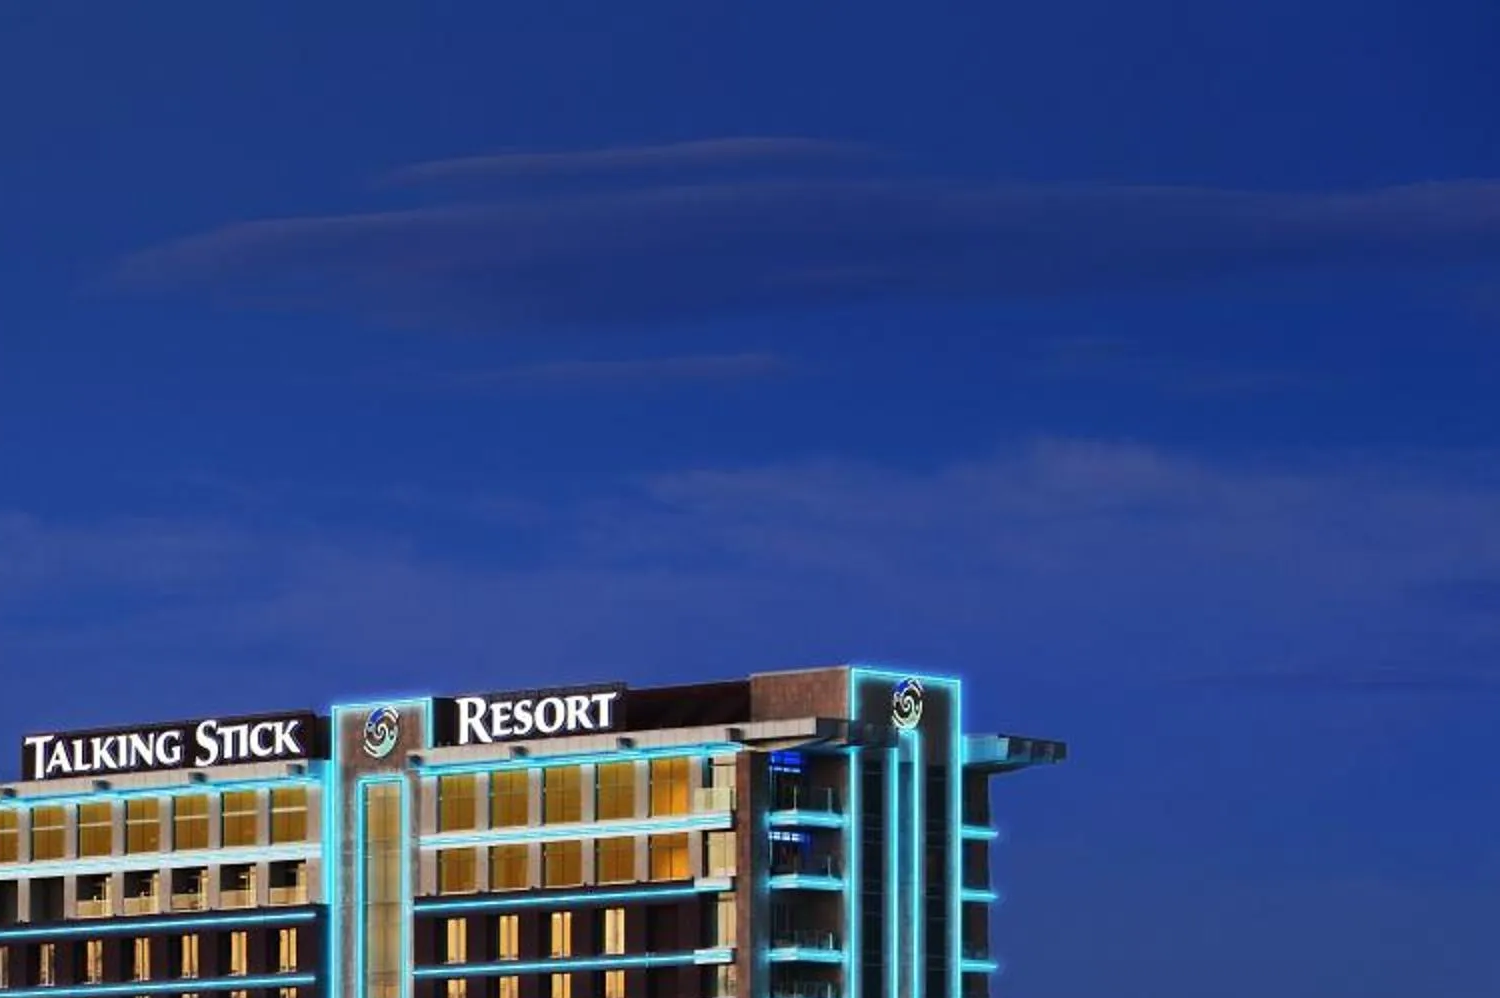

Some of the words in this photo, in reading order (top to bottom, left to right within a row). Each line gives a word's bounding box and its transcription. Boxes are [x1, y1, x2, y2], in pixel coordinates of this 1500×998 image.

[455, 691, 617, 745] RESORT
[25, 730, 181, 780] TALKING
[195, 719, 301, 767] STICK
